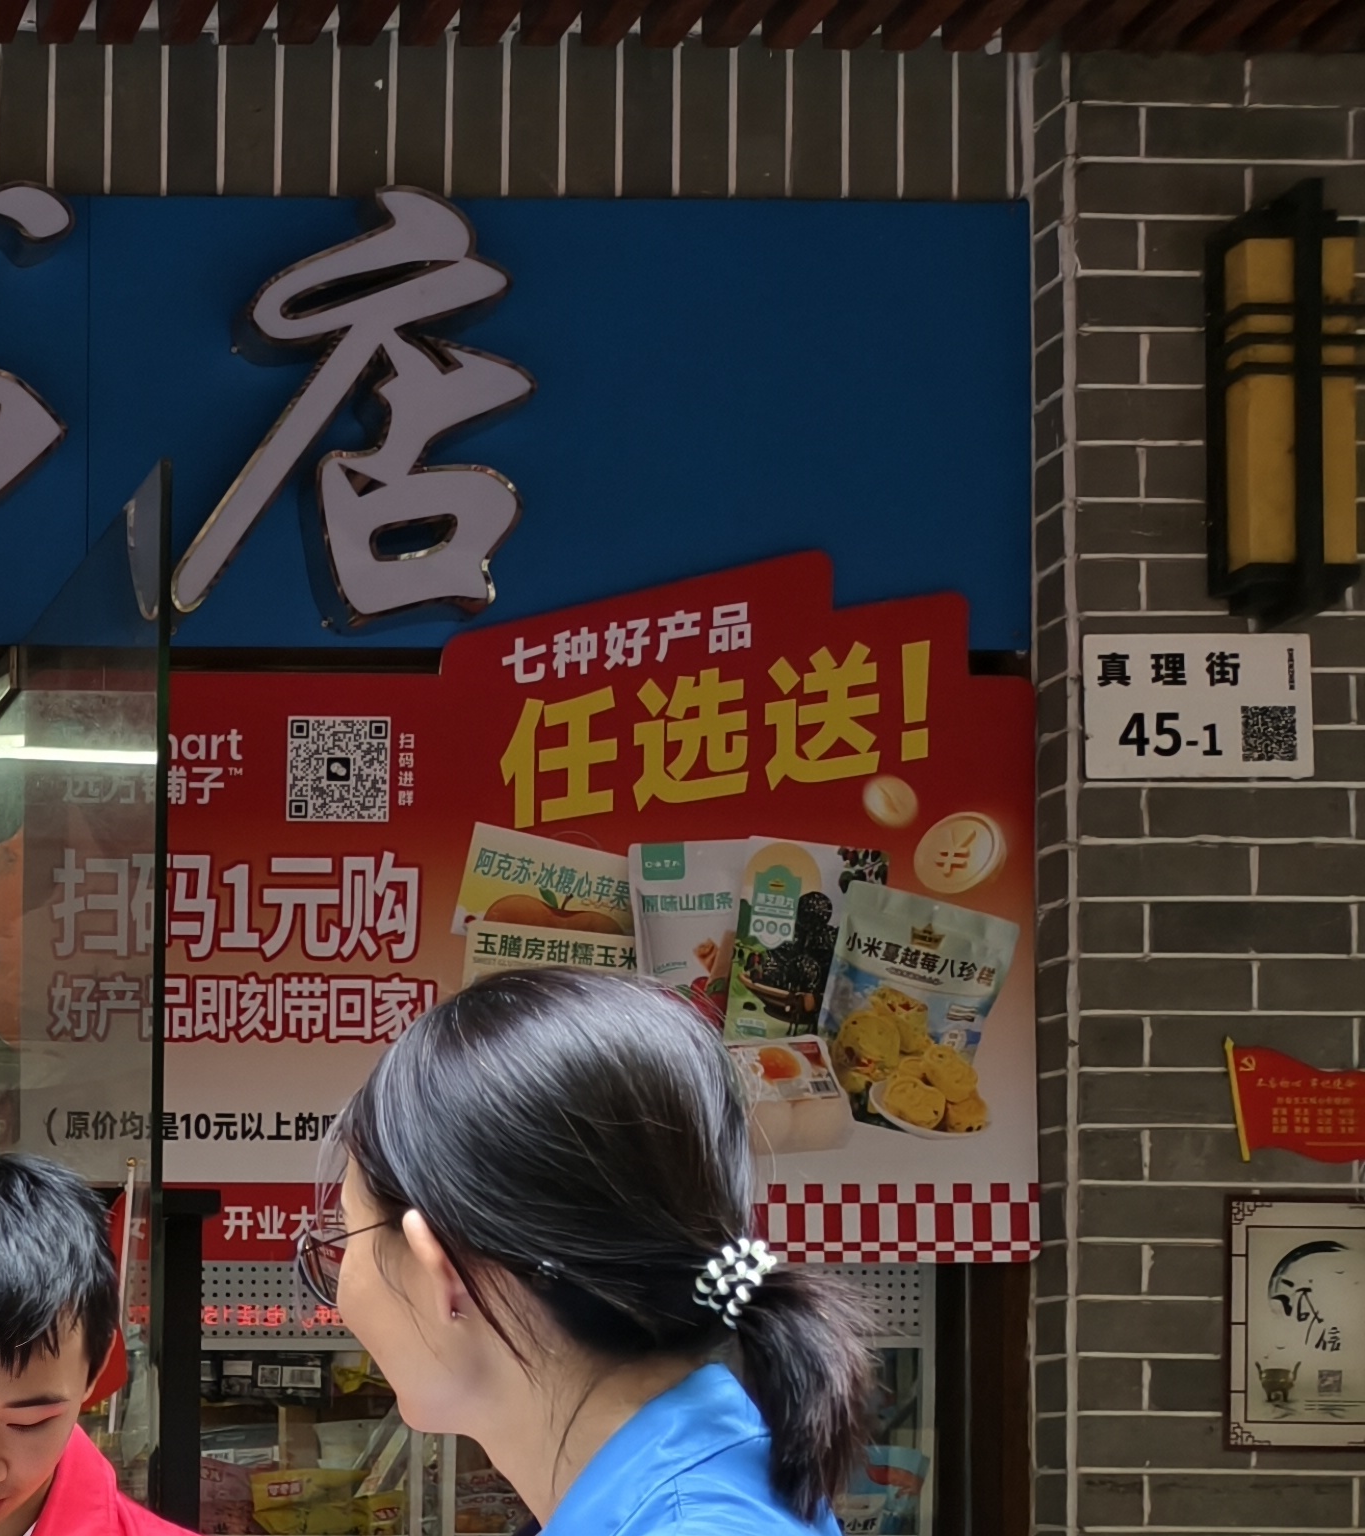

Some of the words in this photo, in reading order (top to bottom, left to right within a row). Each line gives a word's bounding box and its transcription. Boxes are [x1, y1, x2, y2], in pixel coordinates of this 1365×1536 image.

[502, 602, 753, 684] 七种好产品
[1097, 652, 1241, 687] 真理街
[398, 732, 416, 807] 扫码进群
[500, 640, 931, 829] 任选送!
[1119, 712, 1223, 757] 45-1
[52, 849, 421, 962] 扫码1元购
[846, 932, 996, 987] 小米蔓越莓八珍糕
